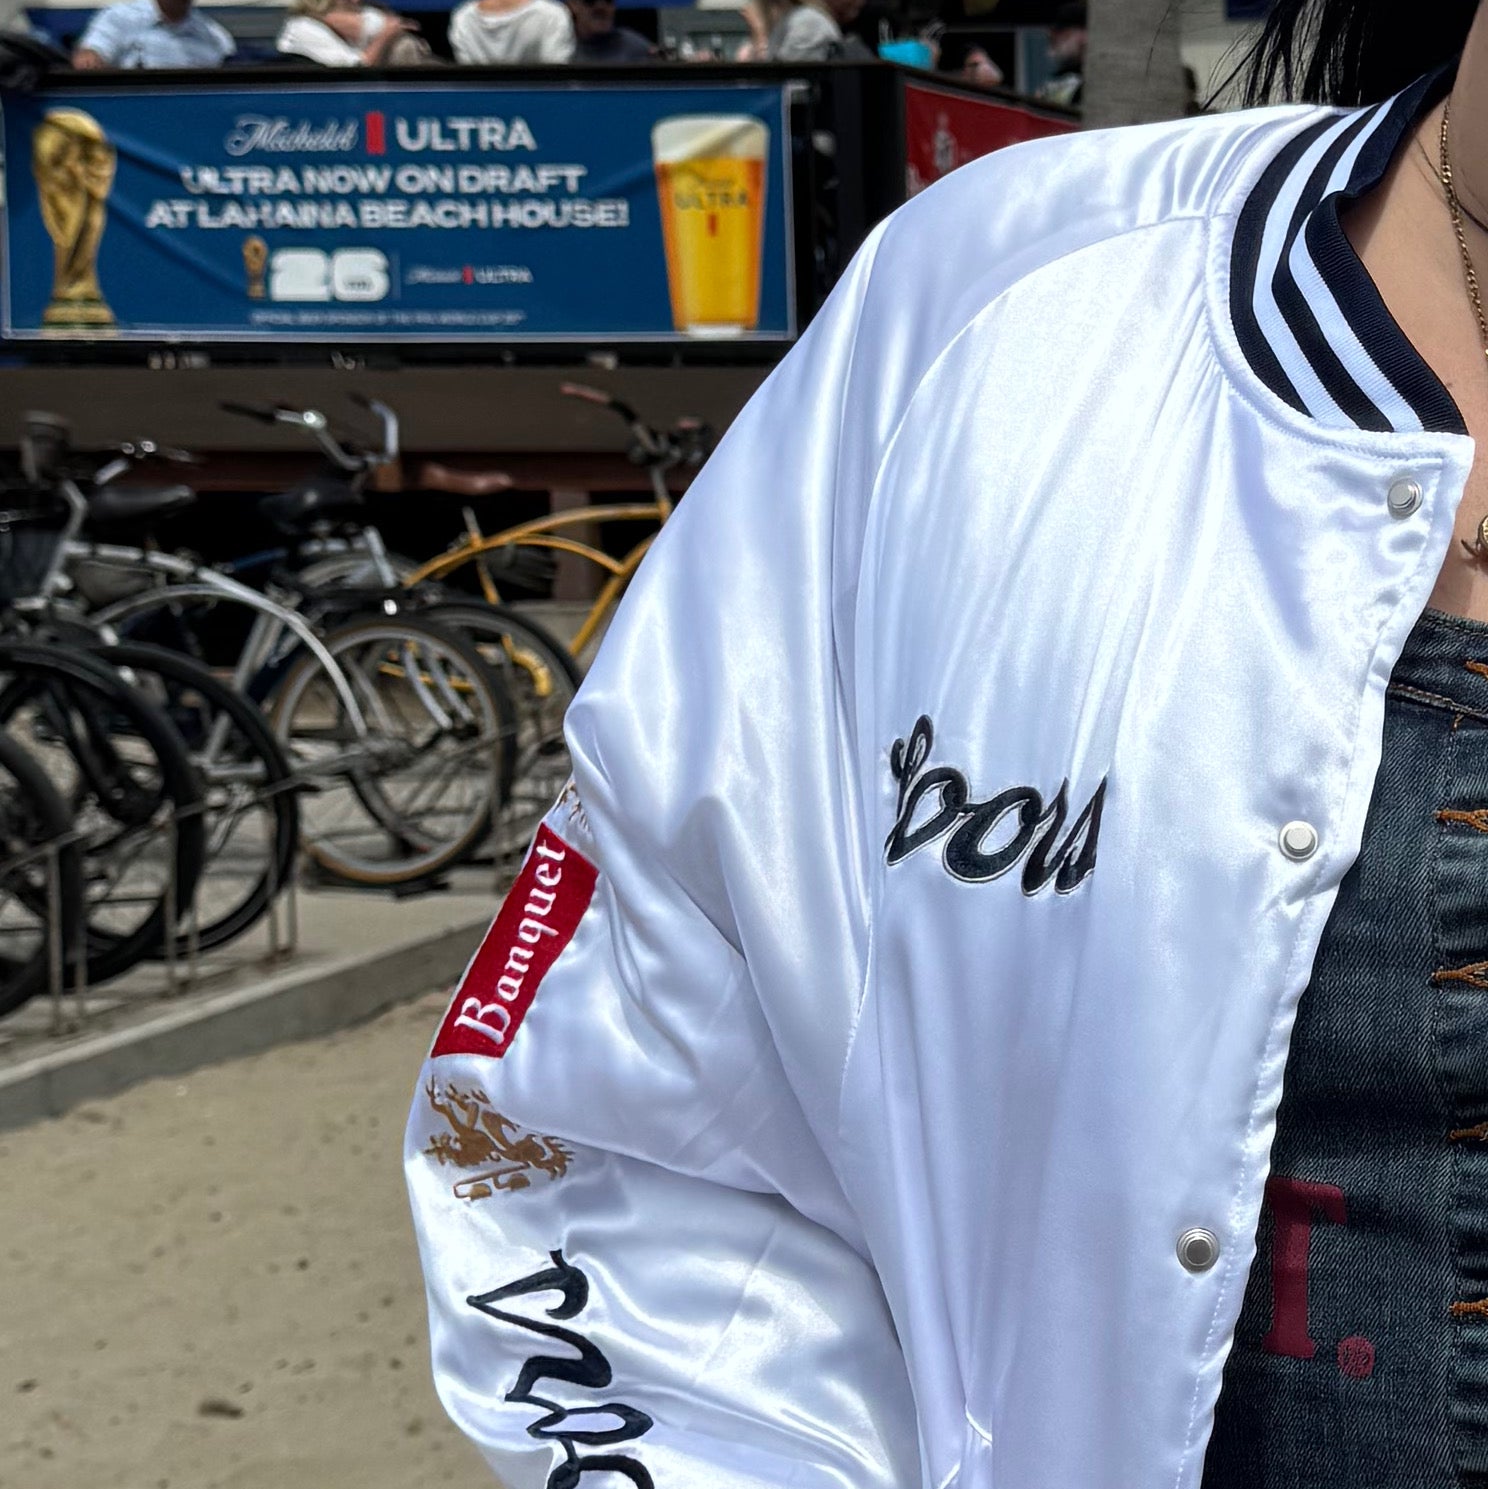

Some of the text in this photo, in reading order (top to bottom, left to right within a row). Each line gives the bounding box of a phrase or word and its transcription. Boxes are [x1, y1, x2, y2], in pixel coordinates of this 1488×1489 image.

[395, 115, 539, 152] ULTRA
[180, 163, 588, 195] ULTRA NOW ON DRAFT
[145, 197, 631, 230] AT LAHAINA BEACH HOUSE!
[270, 246, 390, 303] 26
[454, 839, 566, 1045] Banquet
